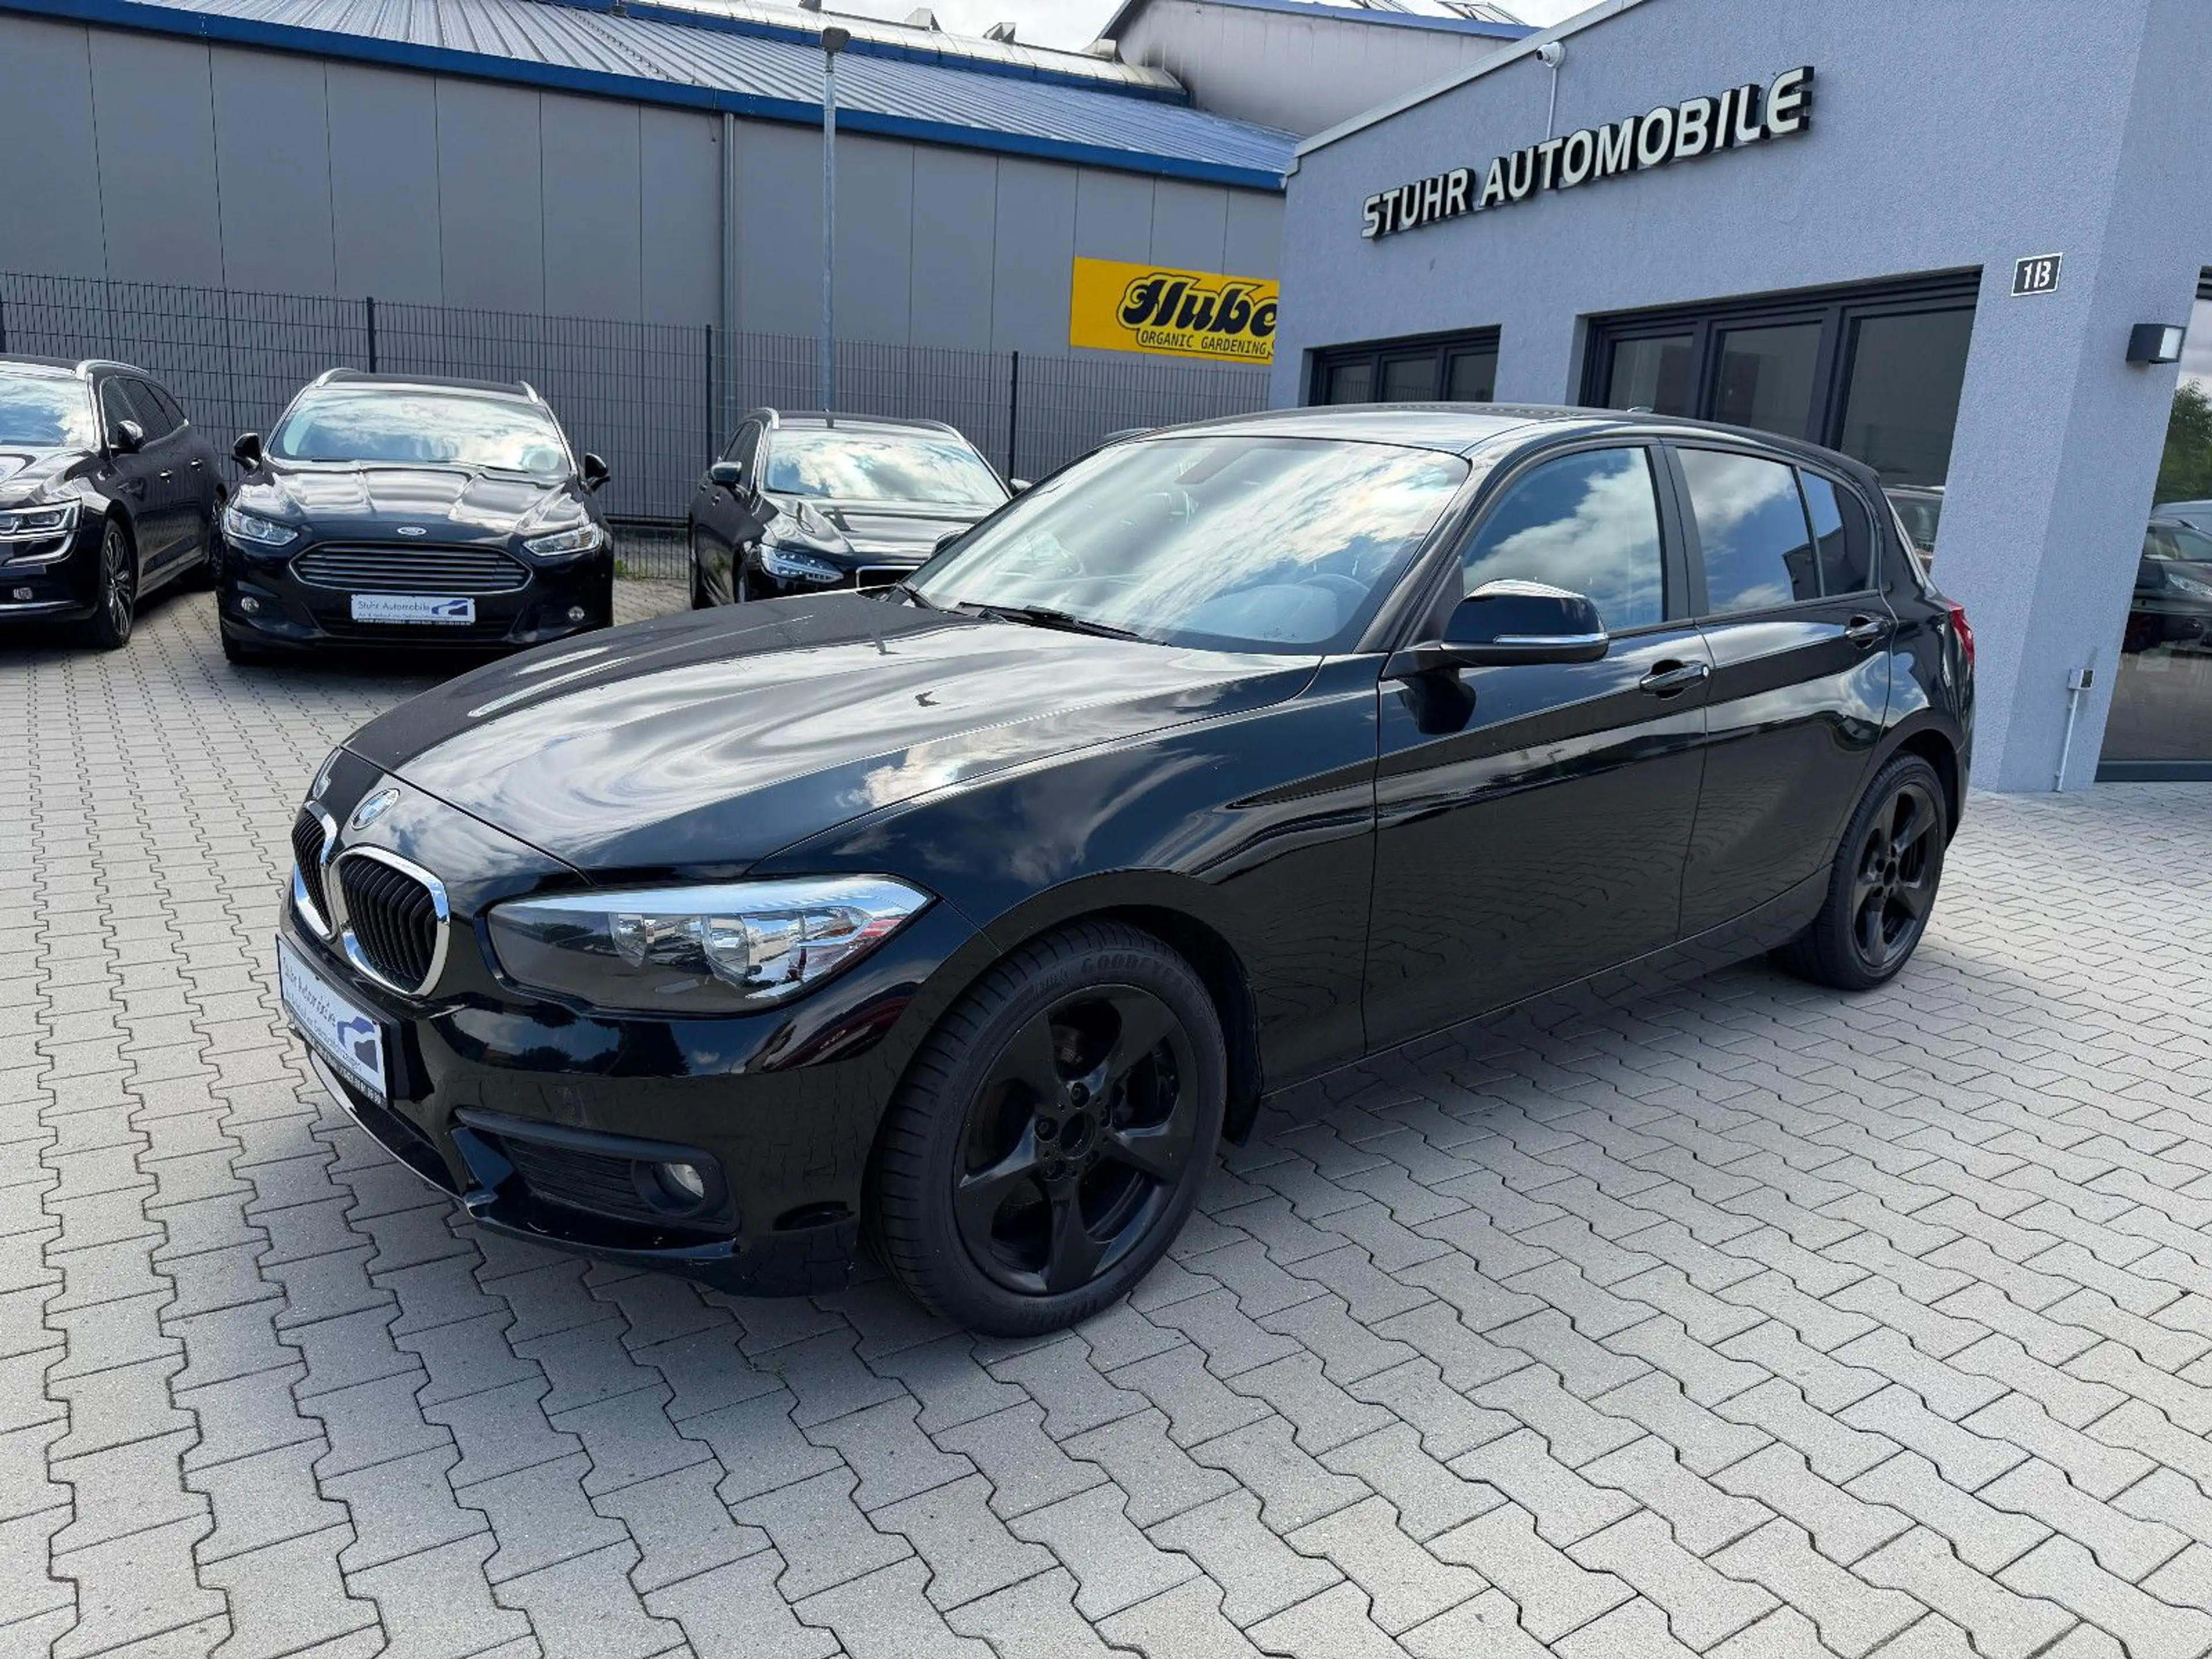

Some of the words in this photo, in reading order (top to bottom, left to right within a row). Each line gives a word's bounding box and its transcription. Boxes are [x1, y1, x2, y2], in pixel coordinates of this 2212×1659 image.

[1361, 166, 1475, 239] STUHR
[1479, 66, 1814, 209] AUTOMOBILE
[2024, 262, 2051, 289] 1B
[1141, 331, 1194, 348] ORGANIC
[1201, 337, 1267, 355] GARDENING
